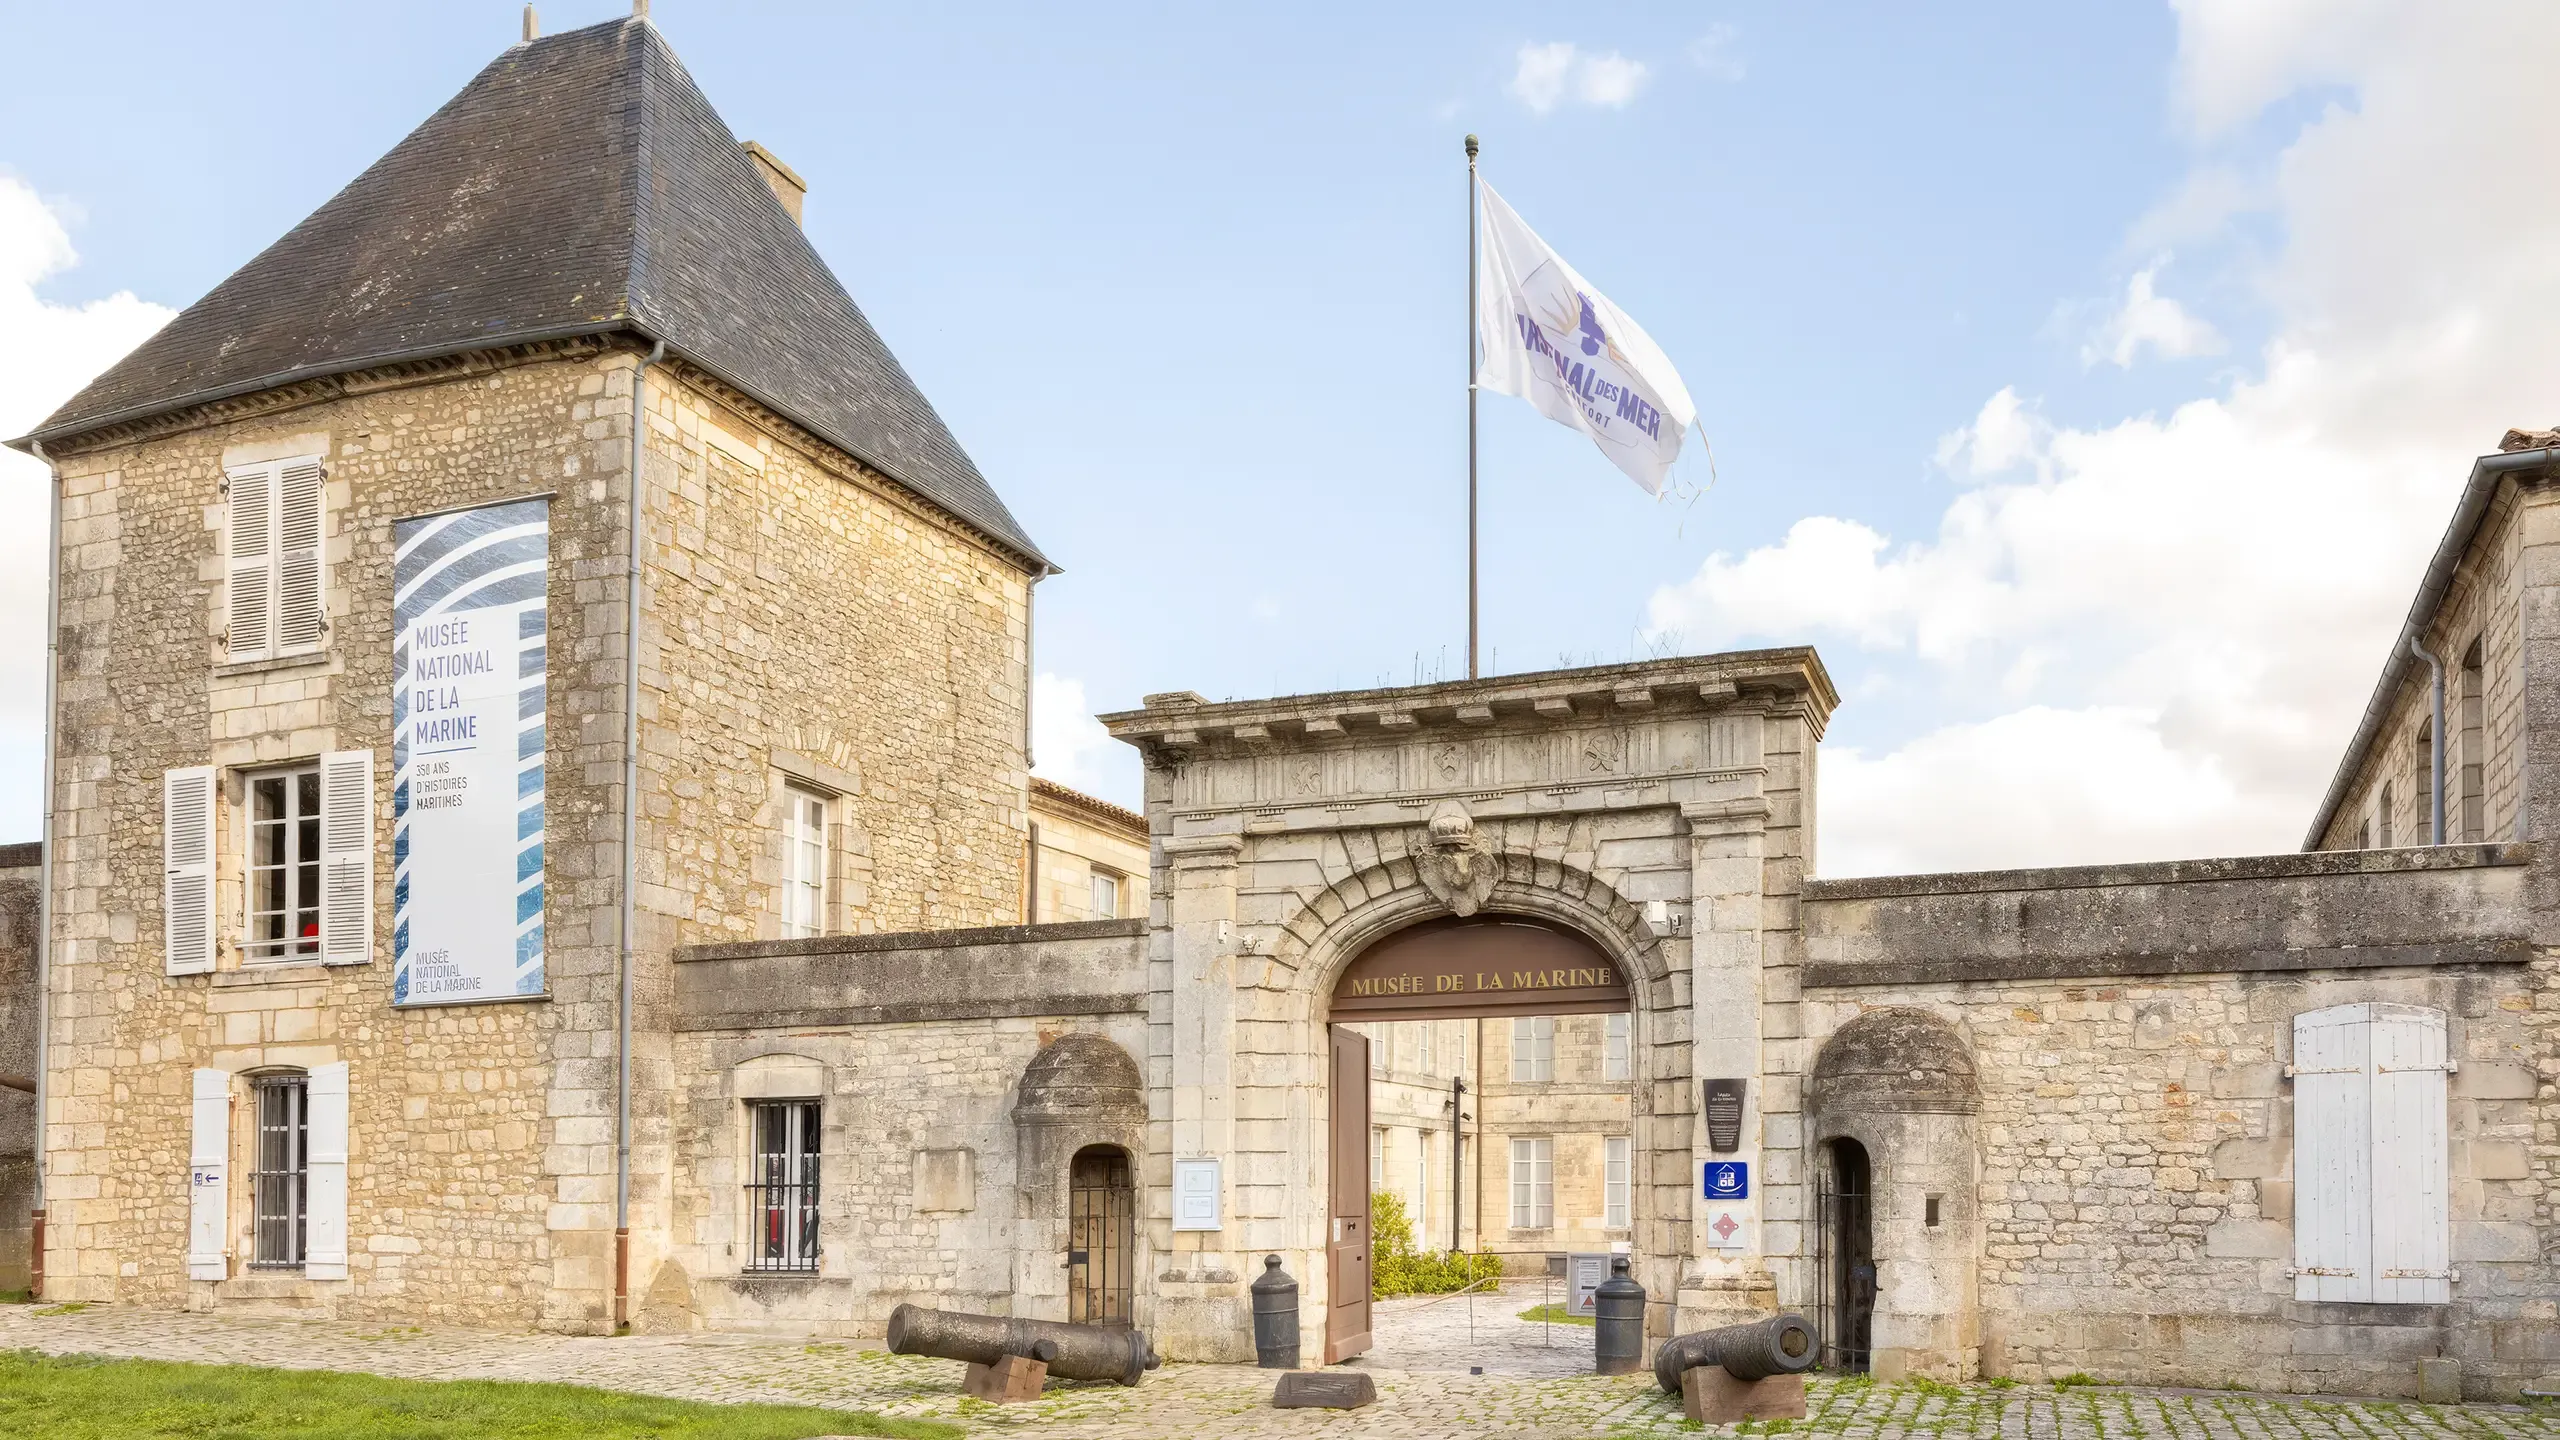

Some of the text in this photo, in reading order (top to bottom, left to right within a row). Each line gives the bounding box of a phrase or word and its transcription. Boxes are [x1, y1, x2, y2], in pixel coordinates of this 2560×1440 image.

[1594, 378, 1619, 402] DES
[416, 616, 469, 651] MUSÉE
[416, 649, 494, 682] NATIONAL
[416, 685, 460, 713] DE LA
[416, 715, 477, 745] MARINE
[432, 761, 450, 775] ANS
[416, 793, 463, 811] MARITIMES
[415, 948, 449, 965] MUSÉE
[415, 963, 461, 979] NATIONAL
[1352, 967, 1611, 997] MUSÉE DE LA MARINE
[415, 976, 482, 994] DE LA MARINE
